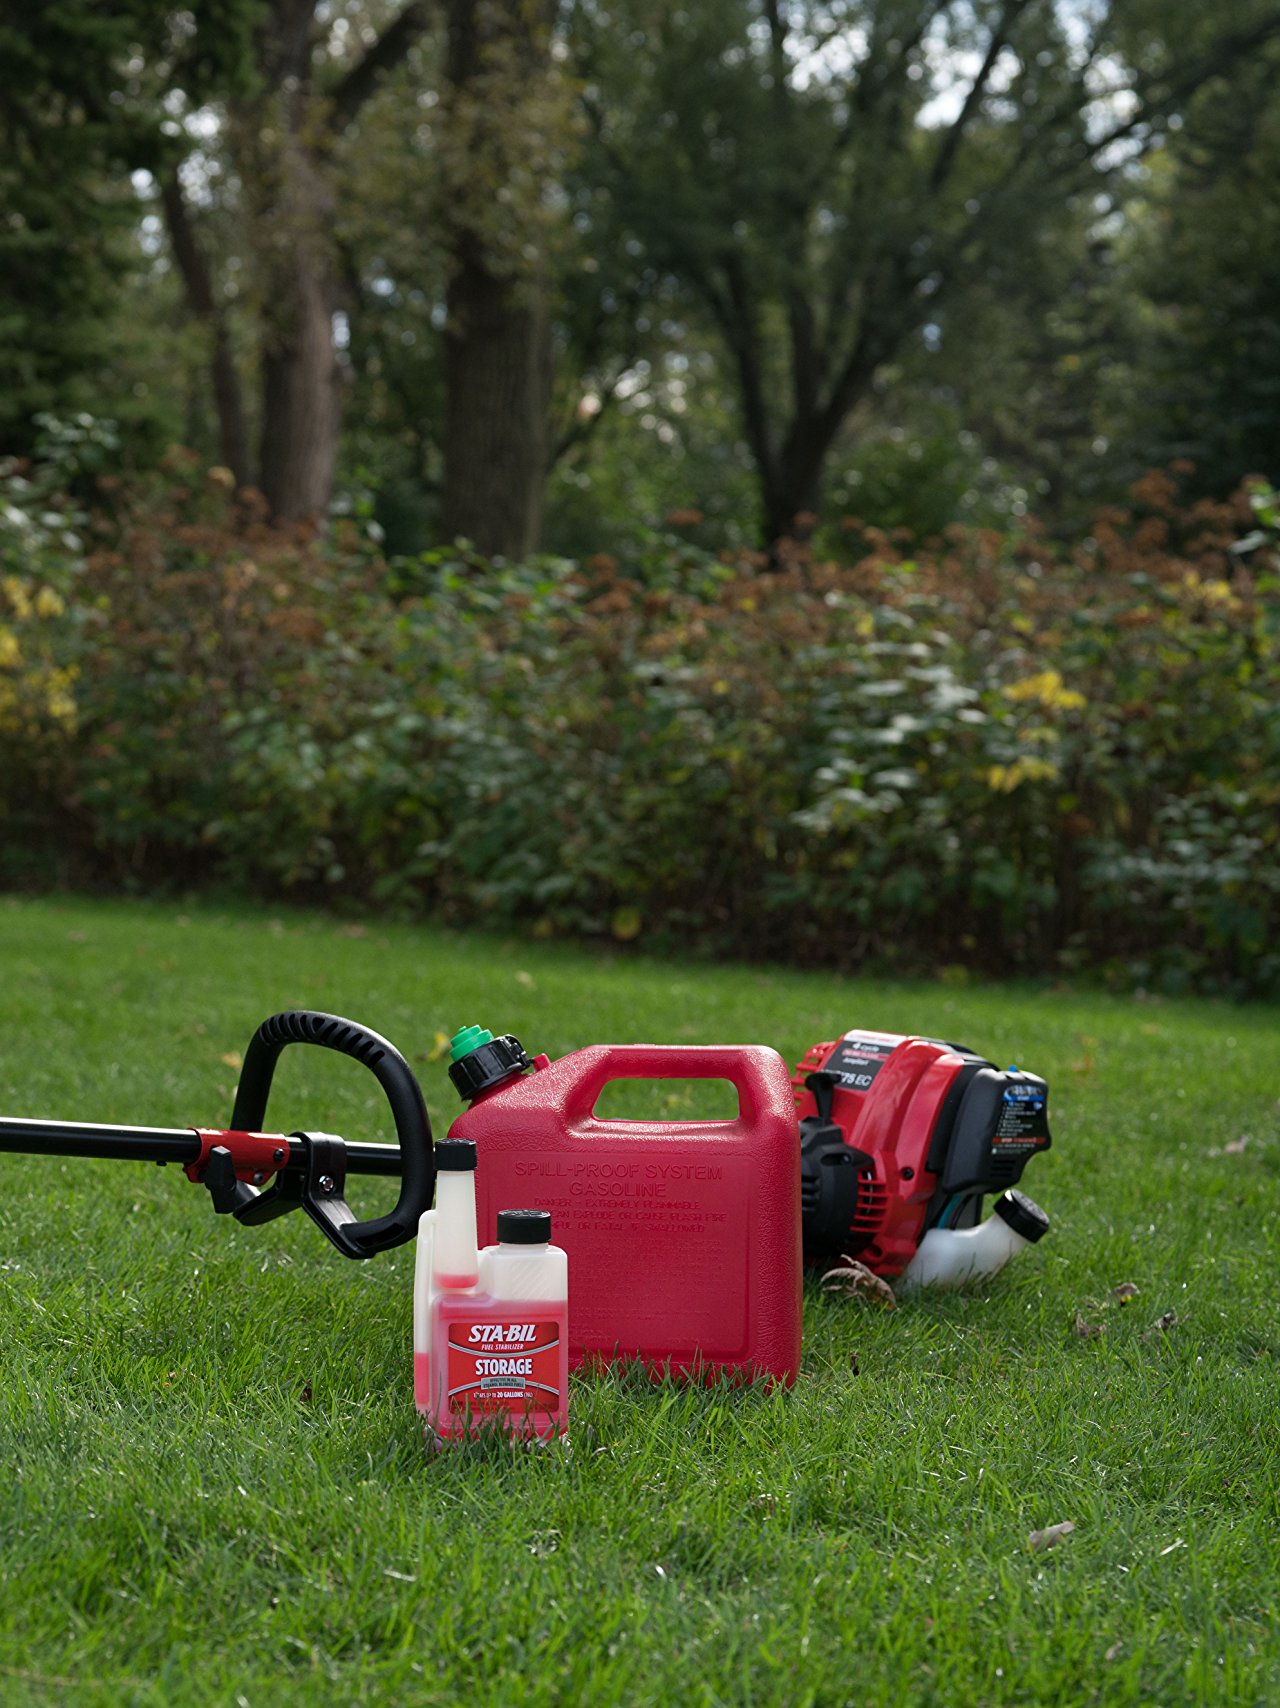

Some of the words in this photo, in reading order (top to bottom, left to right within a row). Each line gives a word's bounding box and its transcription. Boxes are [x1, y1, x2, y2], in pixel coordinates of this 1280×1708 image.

[855, 1074, 872, 1086] EC
[514, 1161, 641, 1178] SPILL-PROOF
[645, 1165, 723, 1180] SYSTEM
[569, 1182, 667, 1198] GASOLINE
[534, 1198, 571, 1207] DANGER
[586, 1199, 639, 1209] EXTREMELY
[643, 1200, 701, 1210] FLAMMABLE
[573, 1211, 615, 1220] EXPLODE
[468, 1324, 537, 1343] STA-BIL
[495, 1343, 524, 1351] STABILIZER
[475, 1358, 533, 1375] STORAGE
